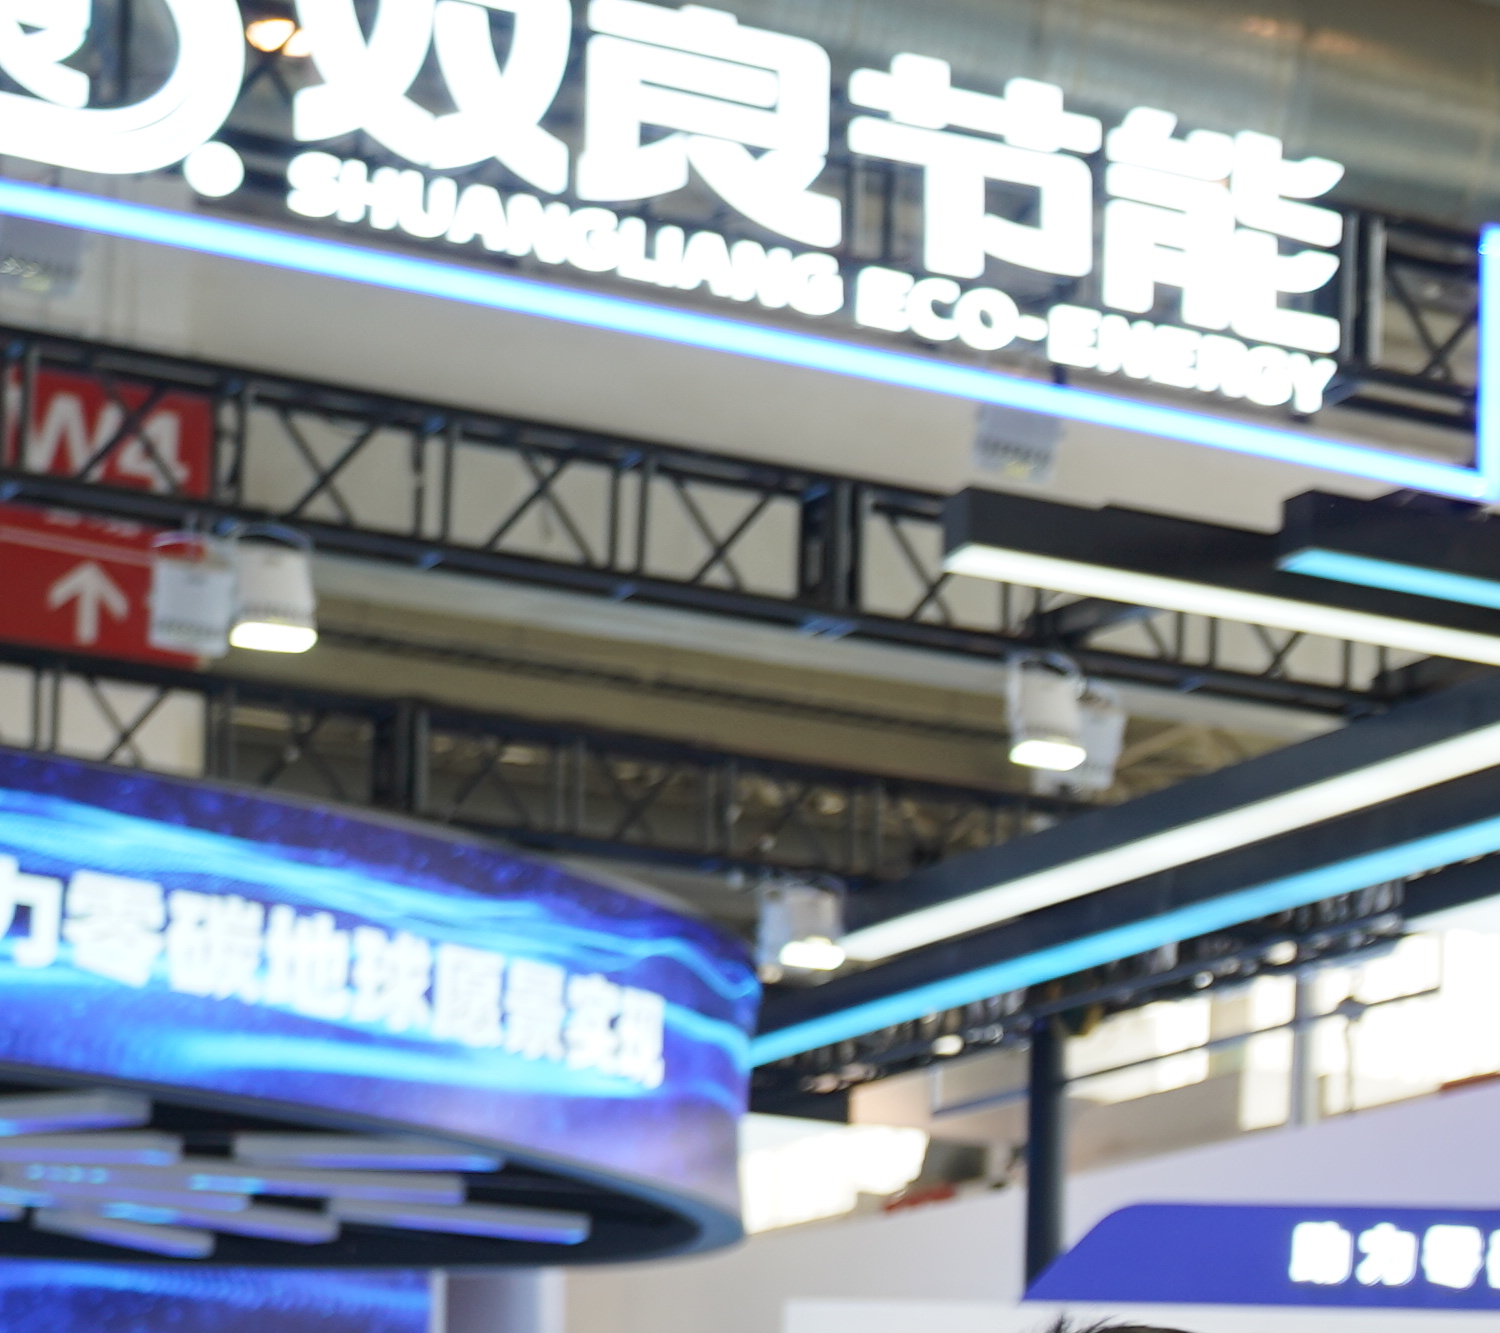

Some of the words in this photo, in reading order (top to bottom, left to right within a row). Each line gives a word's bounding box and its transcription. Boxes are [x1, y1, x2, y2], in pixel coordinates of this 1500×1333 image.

[287, 150, 844, 316] SHUANGLIANG
[854, 266, 1336, 414] ECO-ENERGY
[293, 0, 1344, 354] 双良节能
